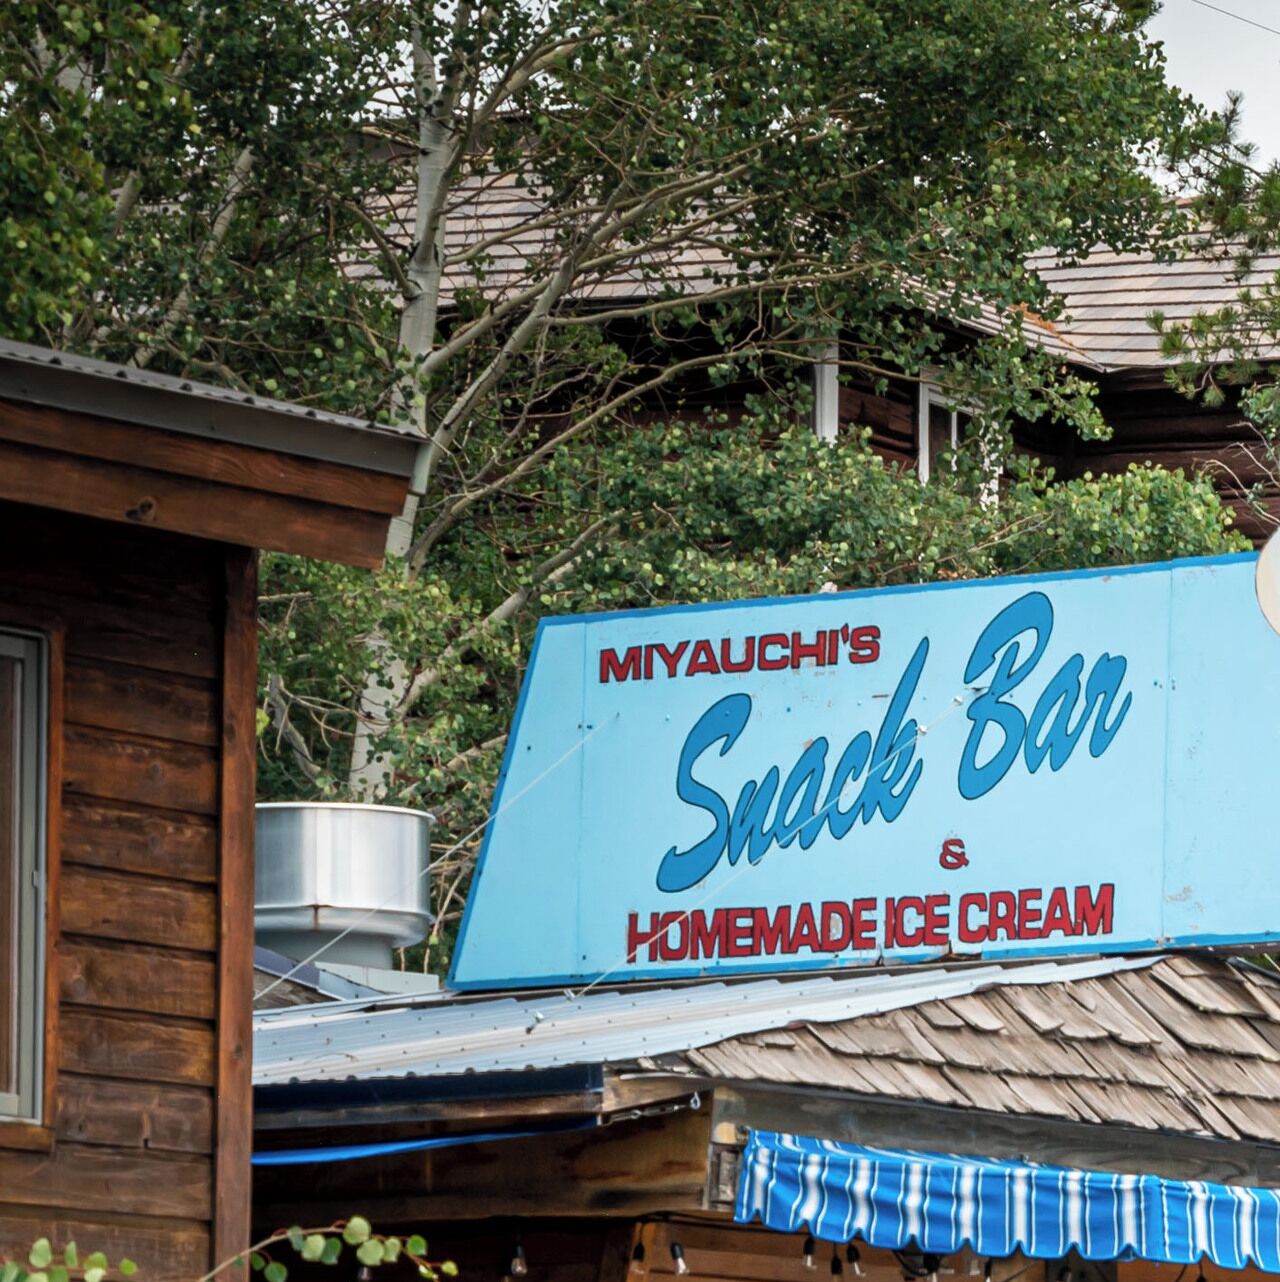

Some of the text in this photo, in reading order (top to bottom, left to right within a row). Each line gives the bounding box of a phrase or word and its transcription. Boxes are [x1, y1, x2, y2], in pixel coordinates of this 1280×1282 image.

[600, 625, 880, 682] MIYAUCHI'S
[655, 590, 1132, 893] Snack Bar
[939, 838, 968, 869] &
[627, 883, 1114, 963] HOMEMADE ICE CREAM
